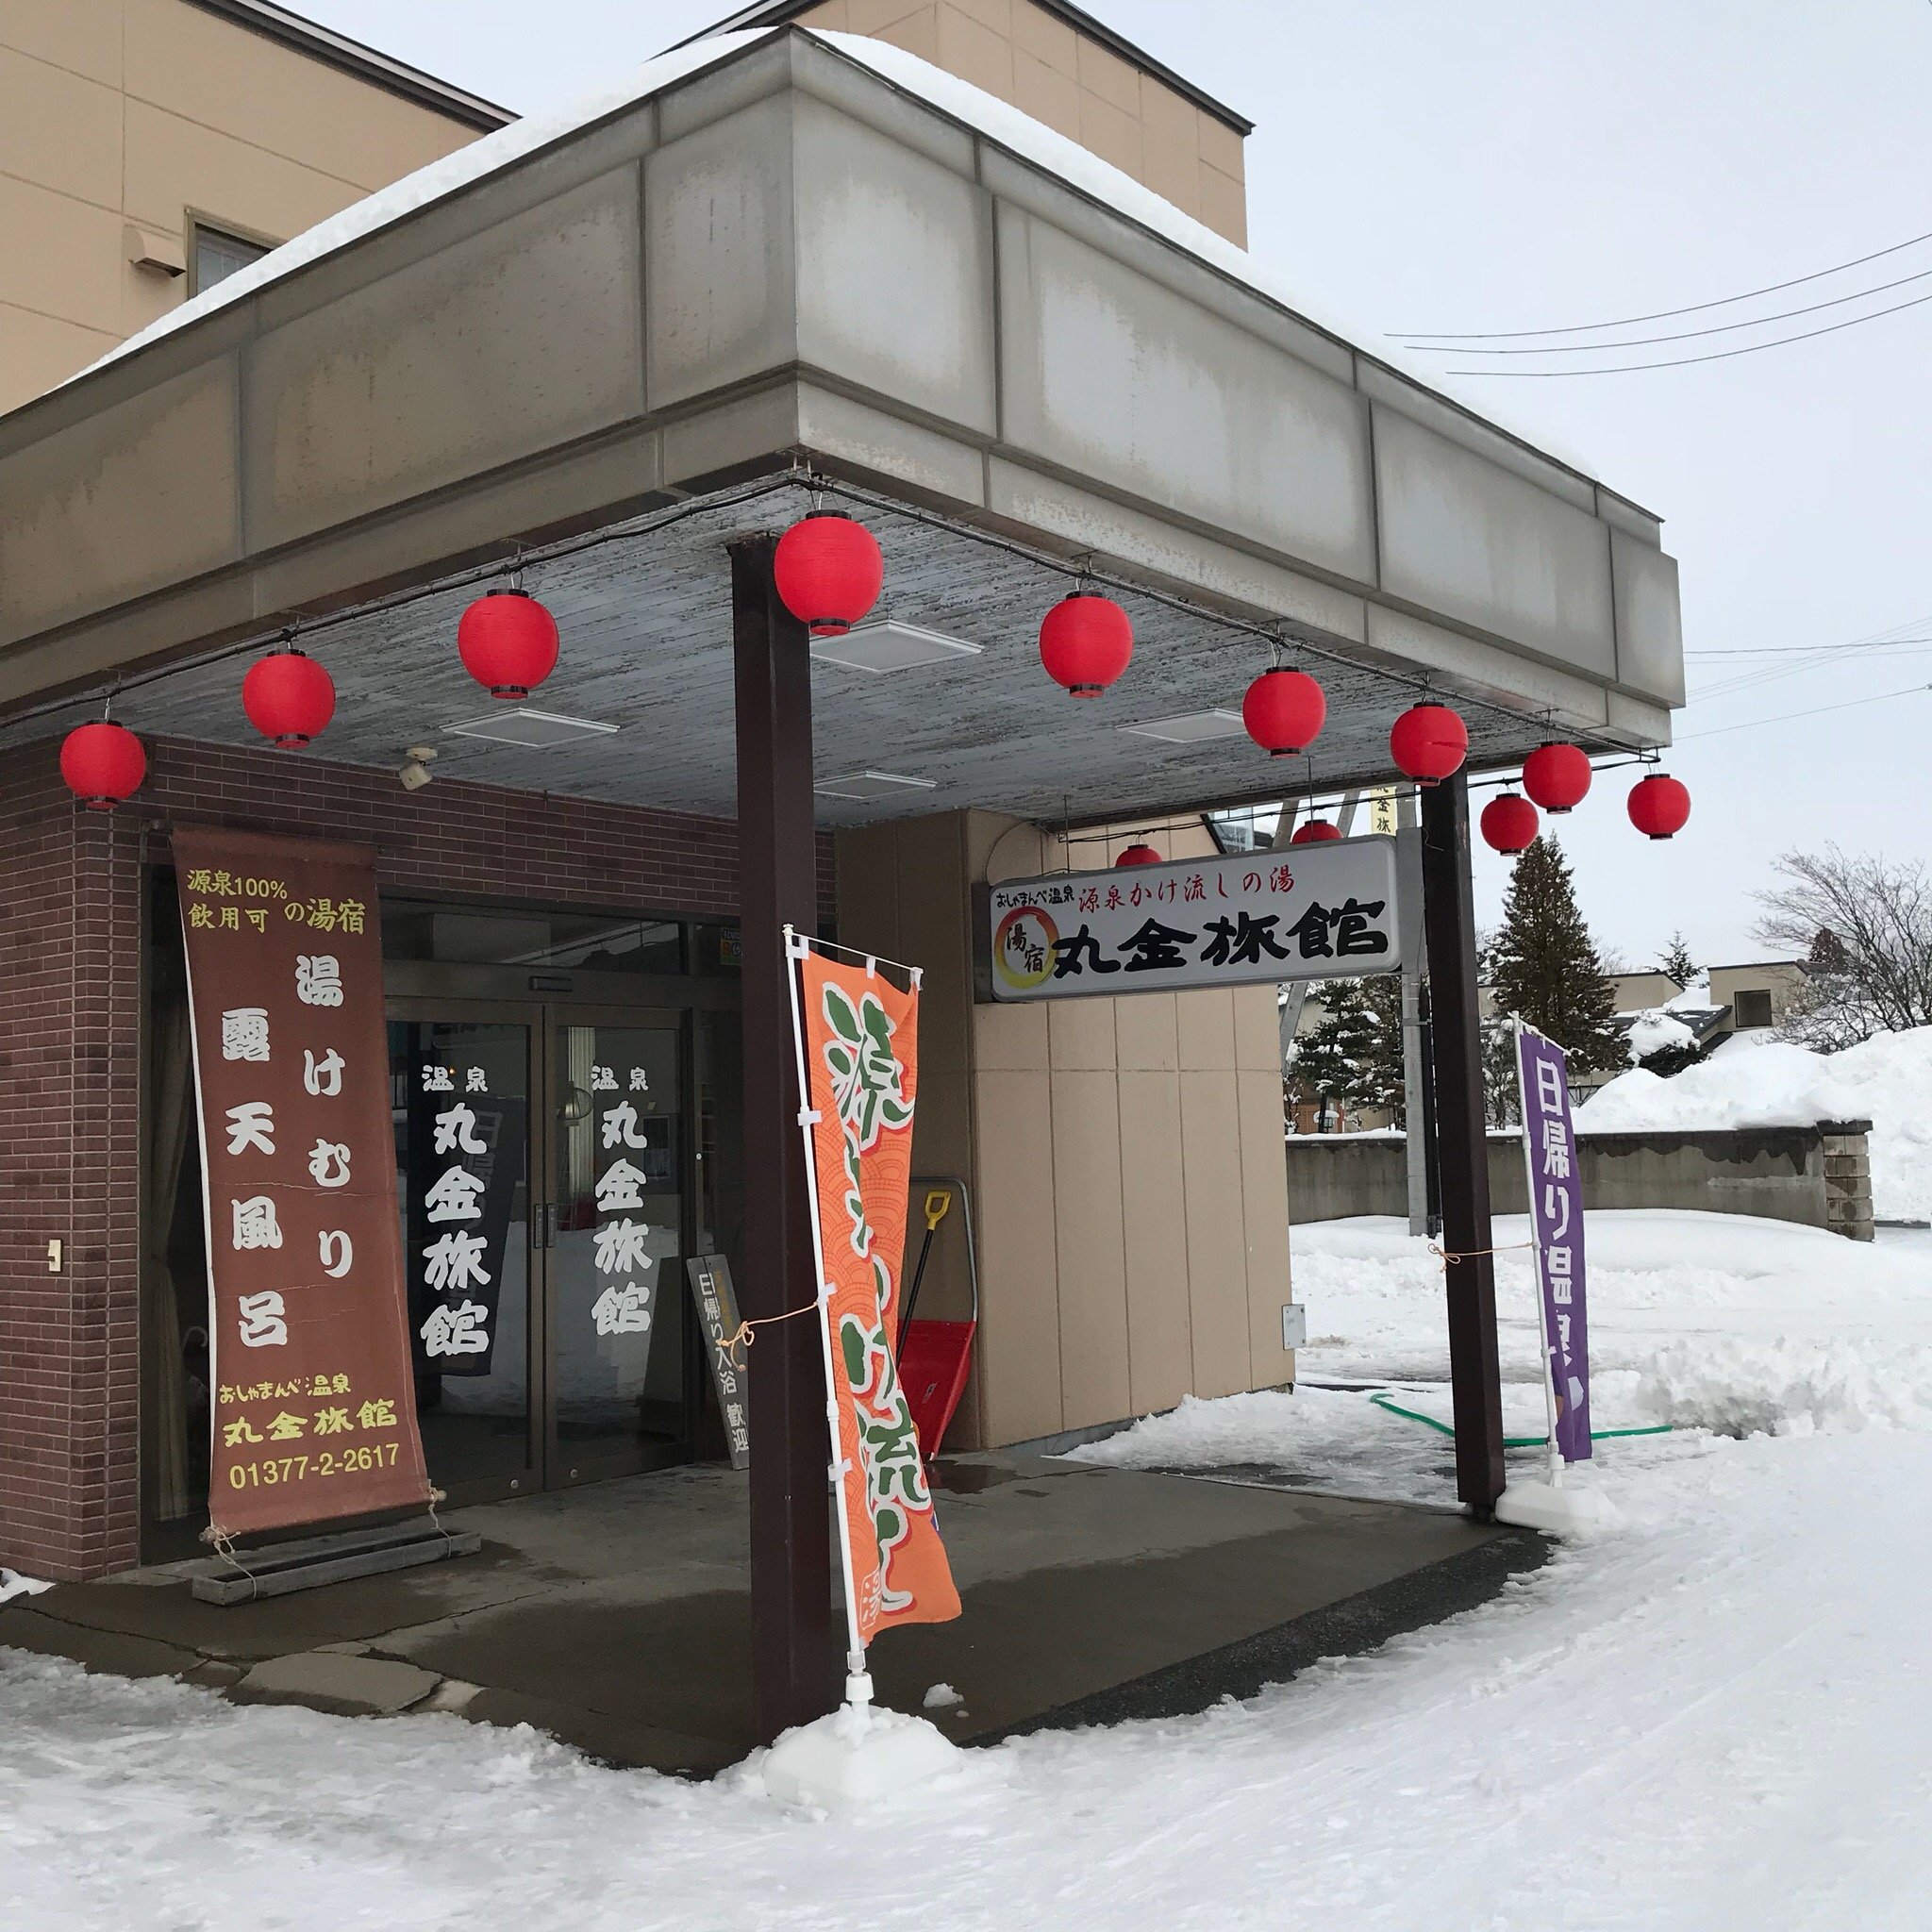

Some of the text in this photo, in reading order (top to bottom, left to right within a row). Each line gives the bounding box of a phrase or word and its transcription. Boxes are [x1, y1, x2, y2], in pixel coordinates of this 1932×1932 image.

[1375, 787, 1391, 833] 金旅
[187, 869, 288, 900] 源泉100%
[996, 884, 1075, 908] おしゃまんべ温泉
[1078, 864, 1295, 914] 源泉かけ流しの湯
[188, 903, 269, 934] 飲用可
[284, 898, 366, 935] の湯宿
[1051, 897, 1389, 979] 丸金旅館
[1007, 923, 1045, 974] 湯宿
[422, 1065, 489, 1092] 温泉
[591, 1065, 650, 1091] 温泉
[294, 955, 353, 1279] 湯けむり
[221, 1008, 288, 1348] 露天風呂
[420, 1102, 491, 1357] 丸金旅館
[591, 1100, 654, 1337] 丸金旅館
[219, 1373, 352, 1405] おしゃまんべ温泉
[222, 1398, 398, 1448] 丸金旅館
[229, 1442, 400, 1490] 01377-2-2617
